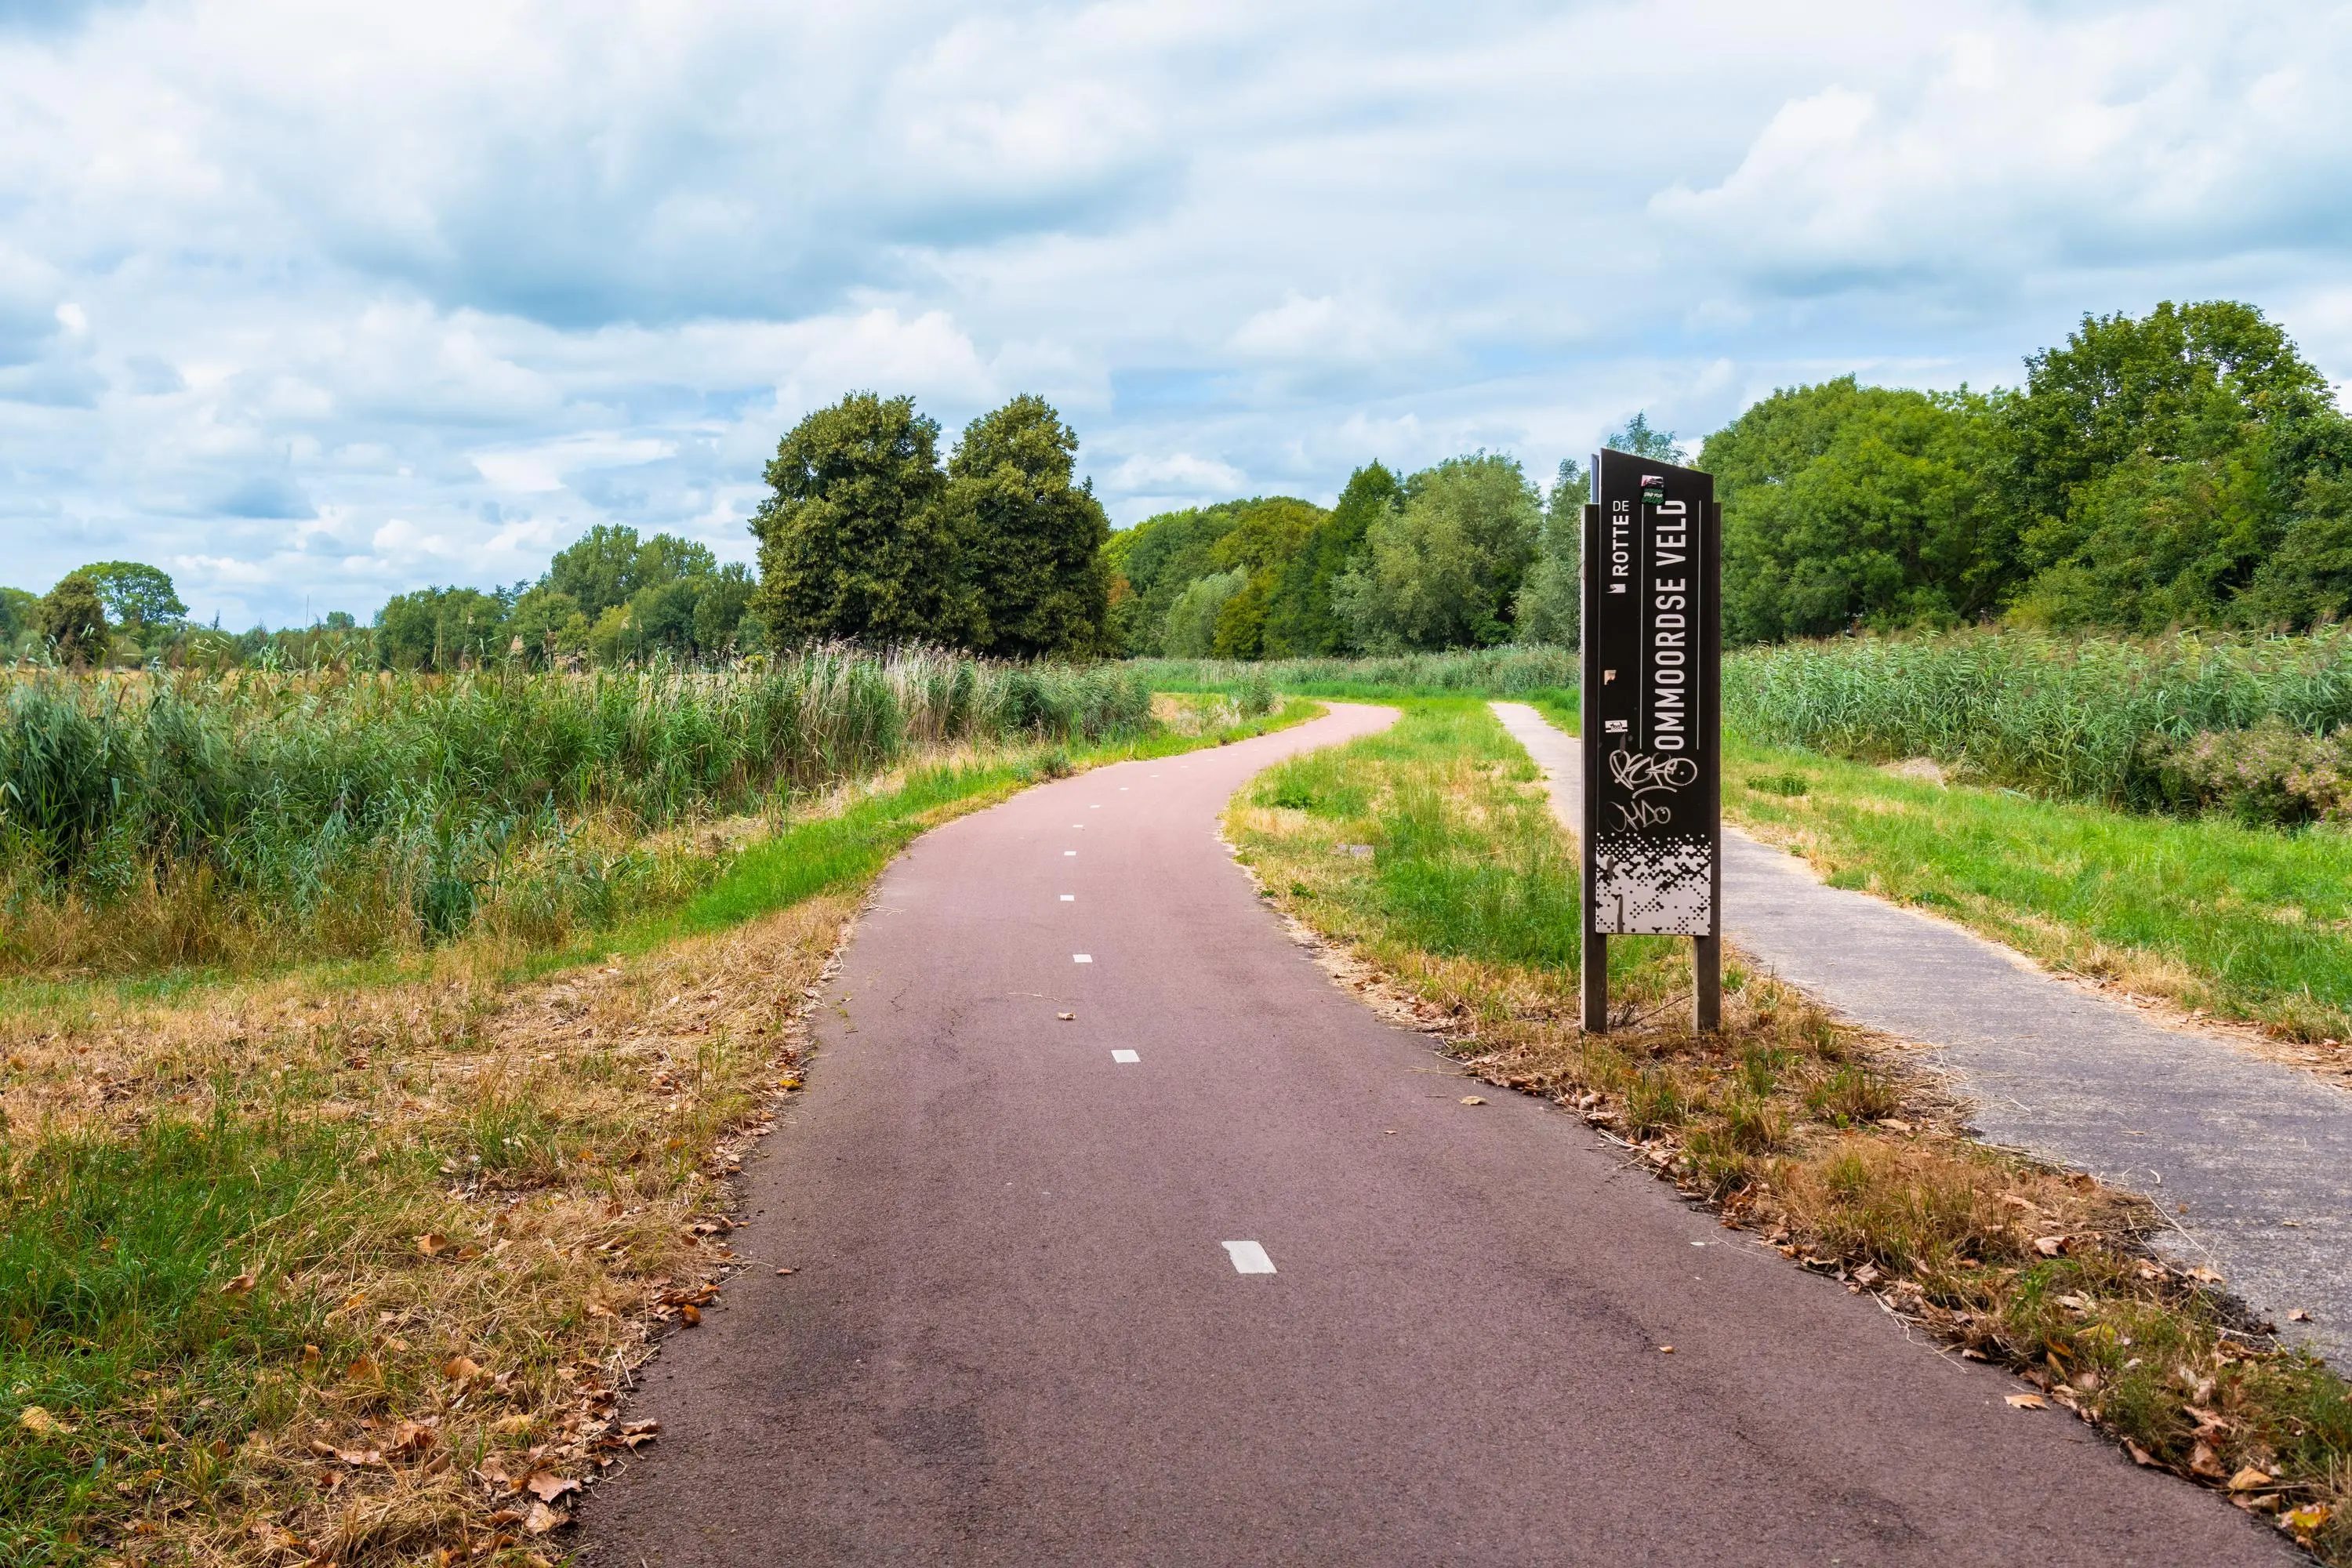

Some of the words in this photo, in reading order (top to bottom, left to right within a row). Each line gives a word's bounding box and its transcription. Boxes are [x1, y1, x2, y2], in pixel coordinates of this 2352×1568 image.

[1613, 500, 1630, 512] DE
[1656, 500, 1686, 566] VELD
[1612, 515, 1629, 576] ROTTE
[1654, 579, 1686, 750] OMMOORDSE
